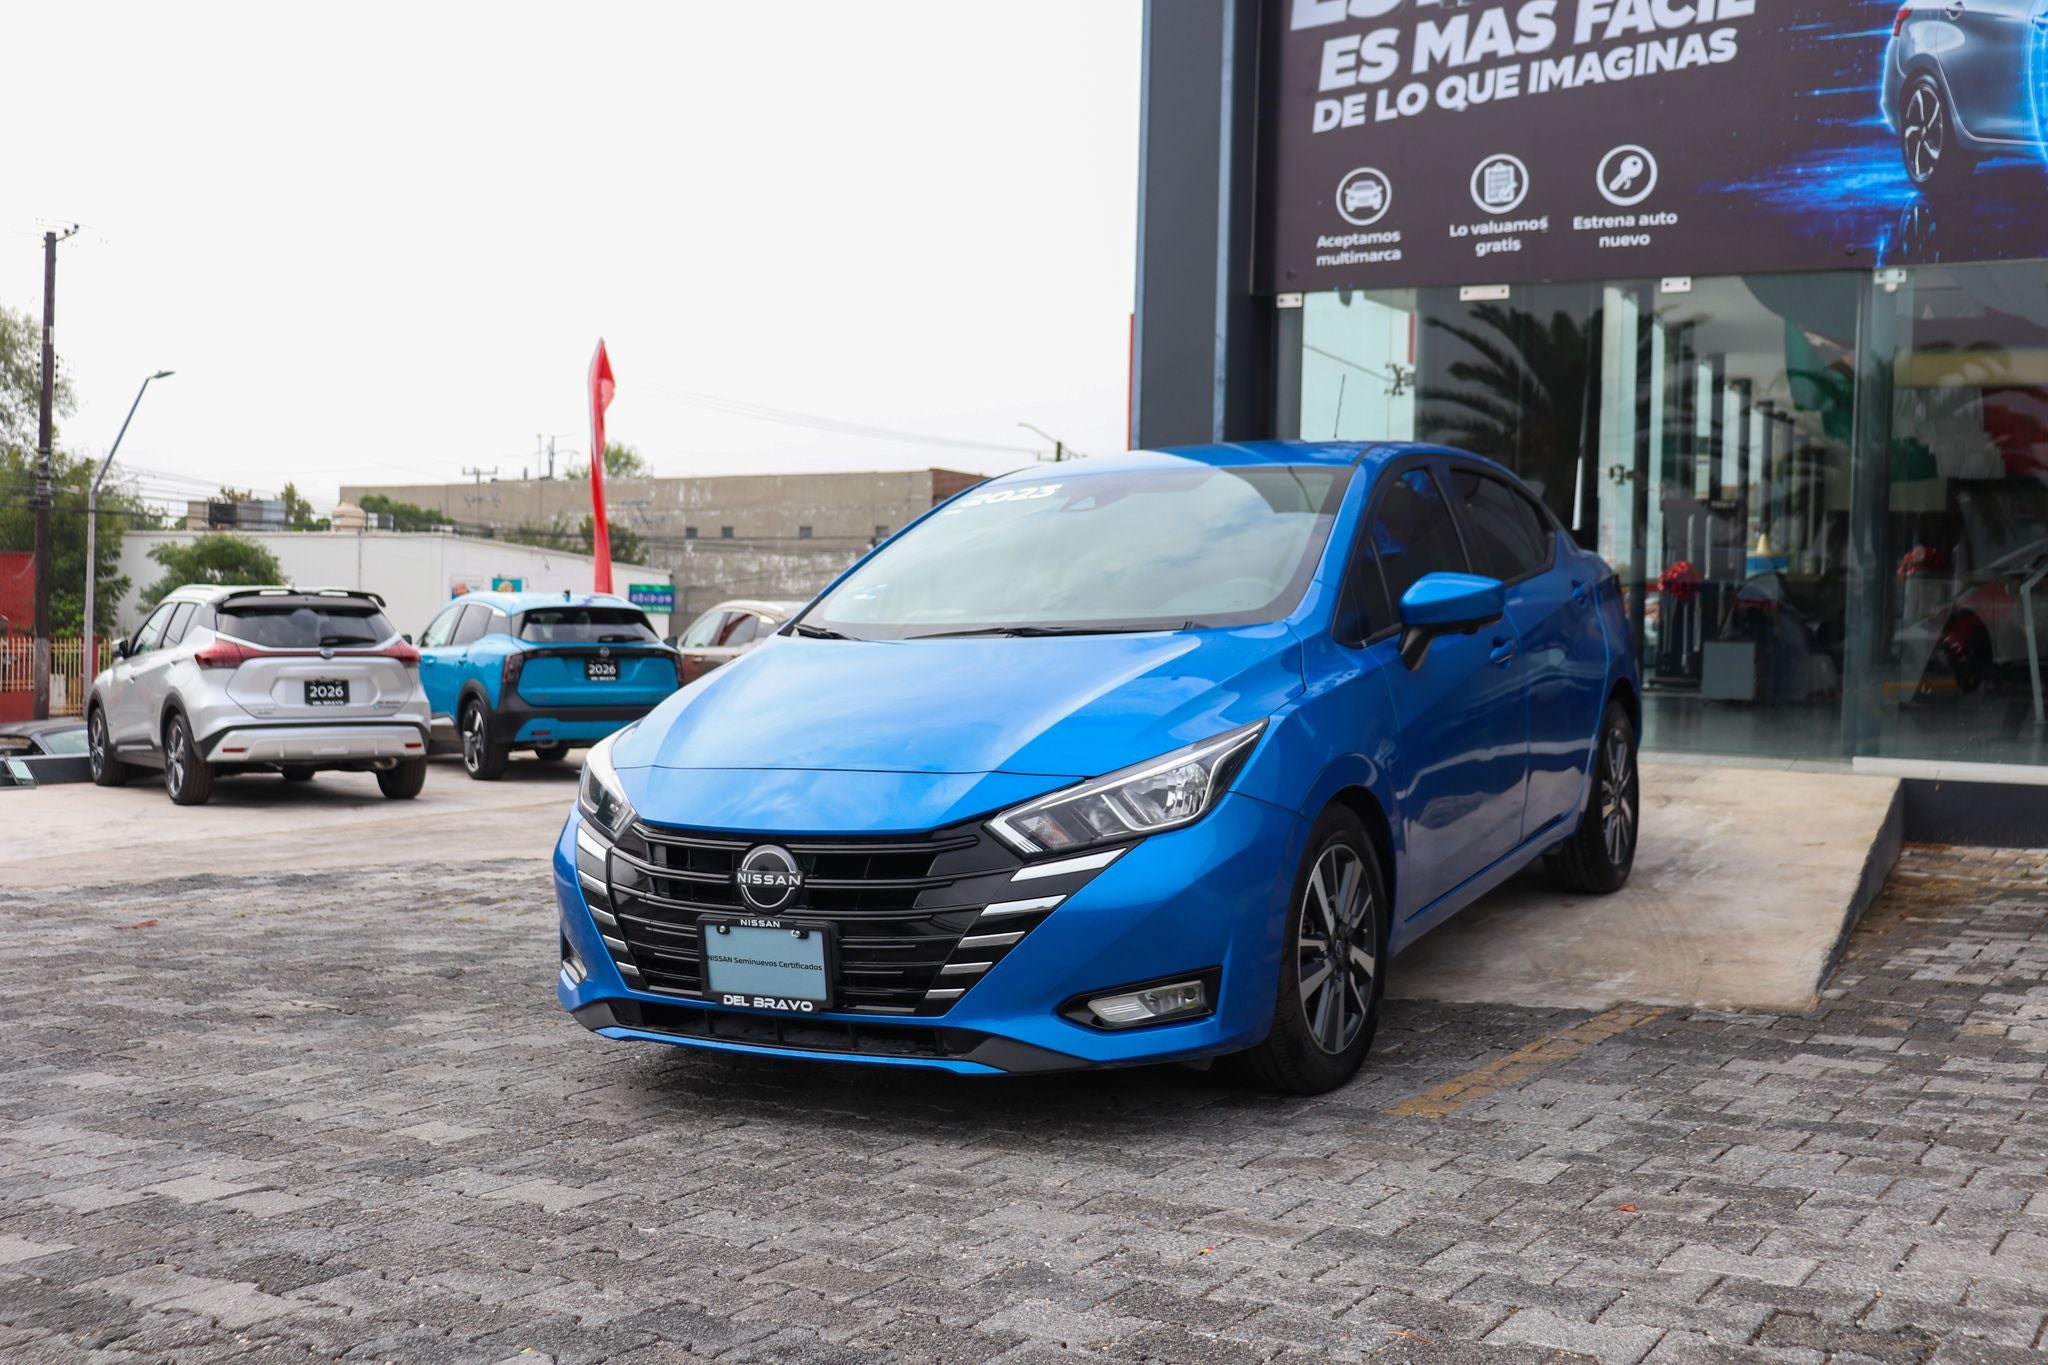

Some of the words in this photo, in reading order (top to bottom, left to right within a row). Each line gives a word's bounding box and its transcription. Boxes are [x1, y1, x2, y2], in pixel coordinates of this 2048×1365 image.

[1317, 27, 1400, 92] ES
[1411, 0, 1558, 75] MAS
[1312, 93, 1368, 134] DE
[1375, 82, 1429, 122] LO
[1435, 64, 1521, 112] QUE
[1527, 27, 1738, 94] IMAGINAS
[1449, 224, 1469, 237] Lo
[1470, 215, 1549, 236] valuamos
[1572, 215, 1636, 231] Estrena
[1638, 211, 1679, 227] auto
[1316, 230, 1402, 249] Aceptamos
[1475, 236, 1522, 258] gratis
[1599, 232, 1651, 248] nuevo
[1316, 249, 1403, 267] multimarca
[588, 664, 616, 675] 2026
[309, 685, 344, 698] 2026
[737, 872, 801, 886] NISSAN
[740, 919, 781, 928] NISSAN
[706, 955, 733, 963] NISSAN
[733, 957, 778, 967] Seminuevos
[778, 961, 823, 971] Certificados
[723, 994, 750, 1006] DEL
[753, 997, 814, 1012] BRAVO
